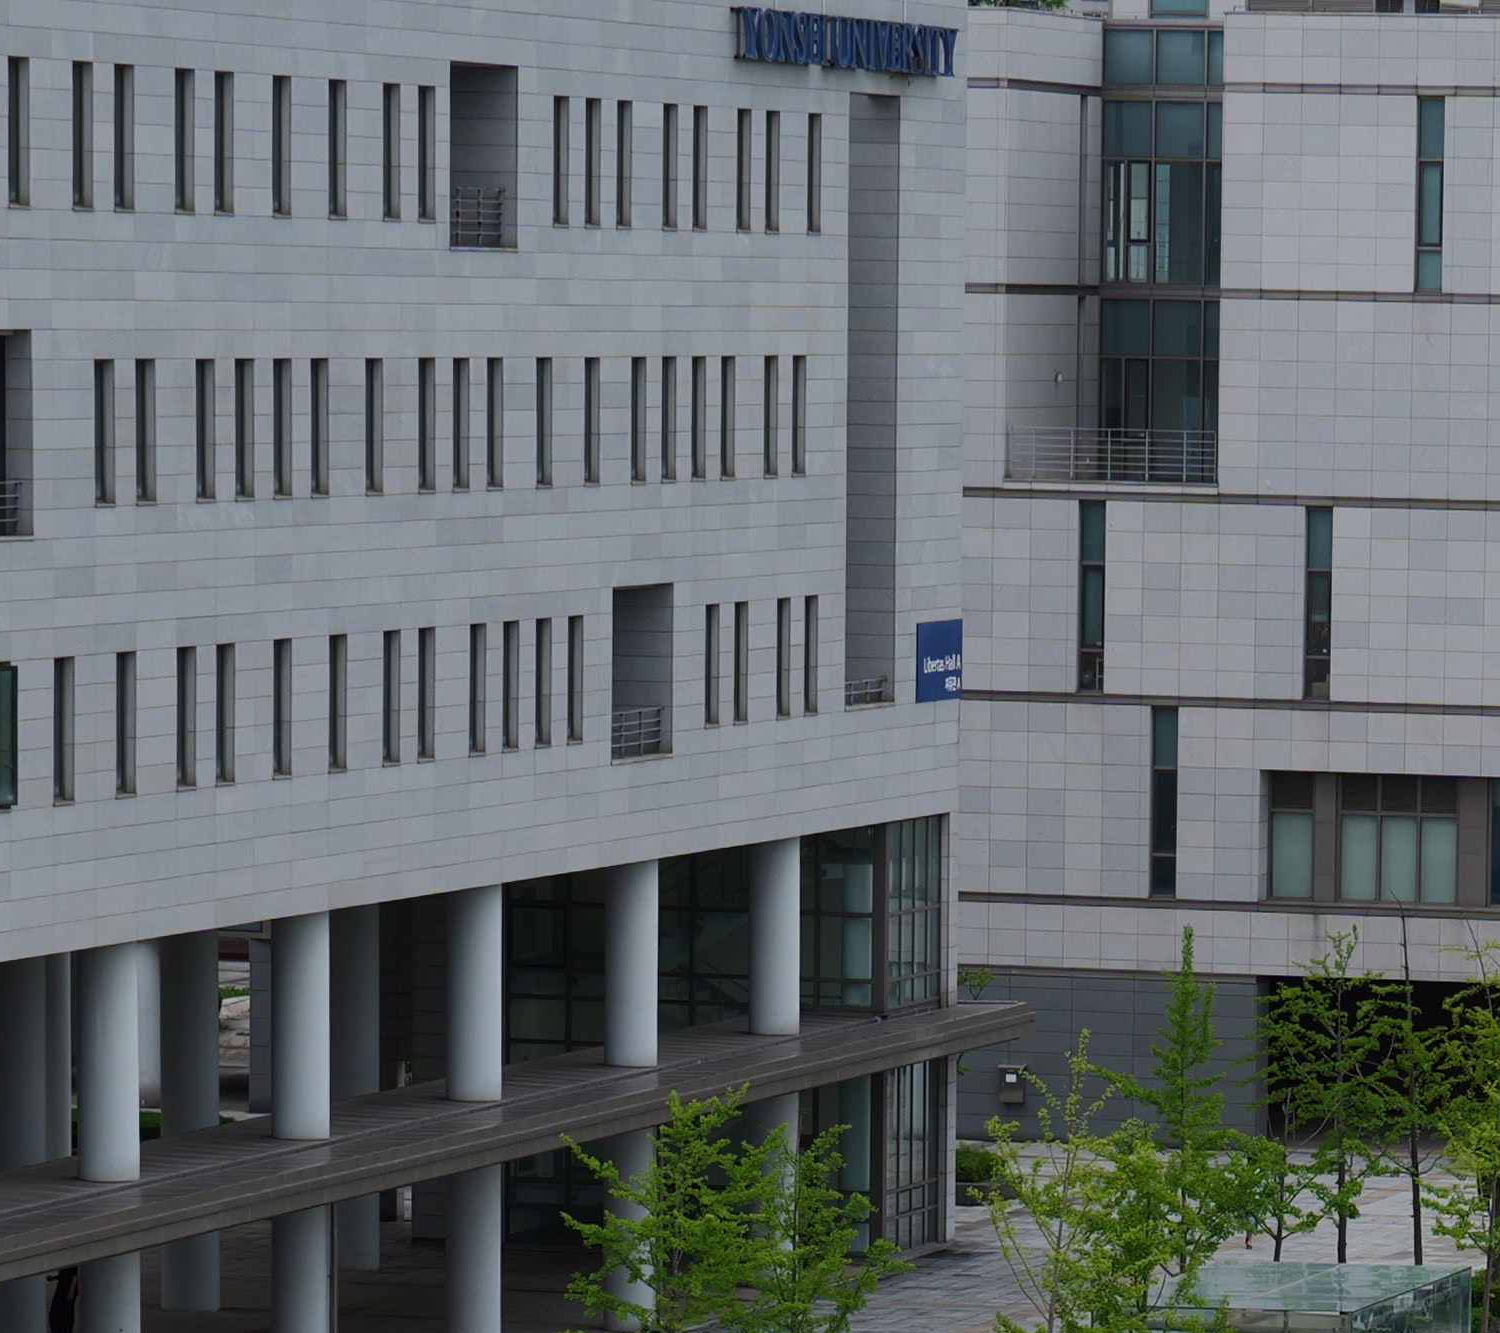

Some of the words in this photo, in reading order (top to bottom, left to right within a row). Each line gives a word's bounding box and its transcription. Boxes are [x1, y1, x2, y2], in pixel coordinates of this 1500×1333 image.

[741, 7, 828, 66] YONSEI
[829, 14, 959, 77] UNIVERSITY
[945, 653, 956, 671] Hall
